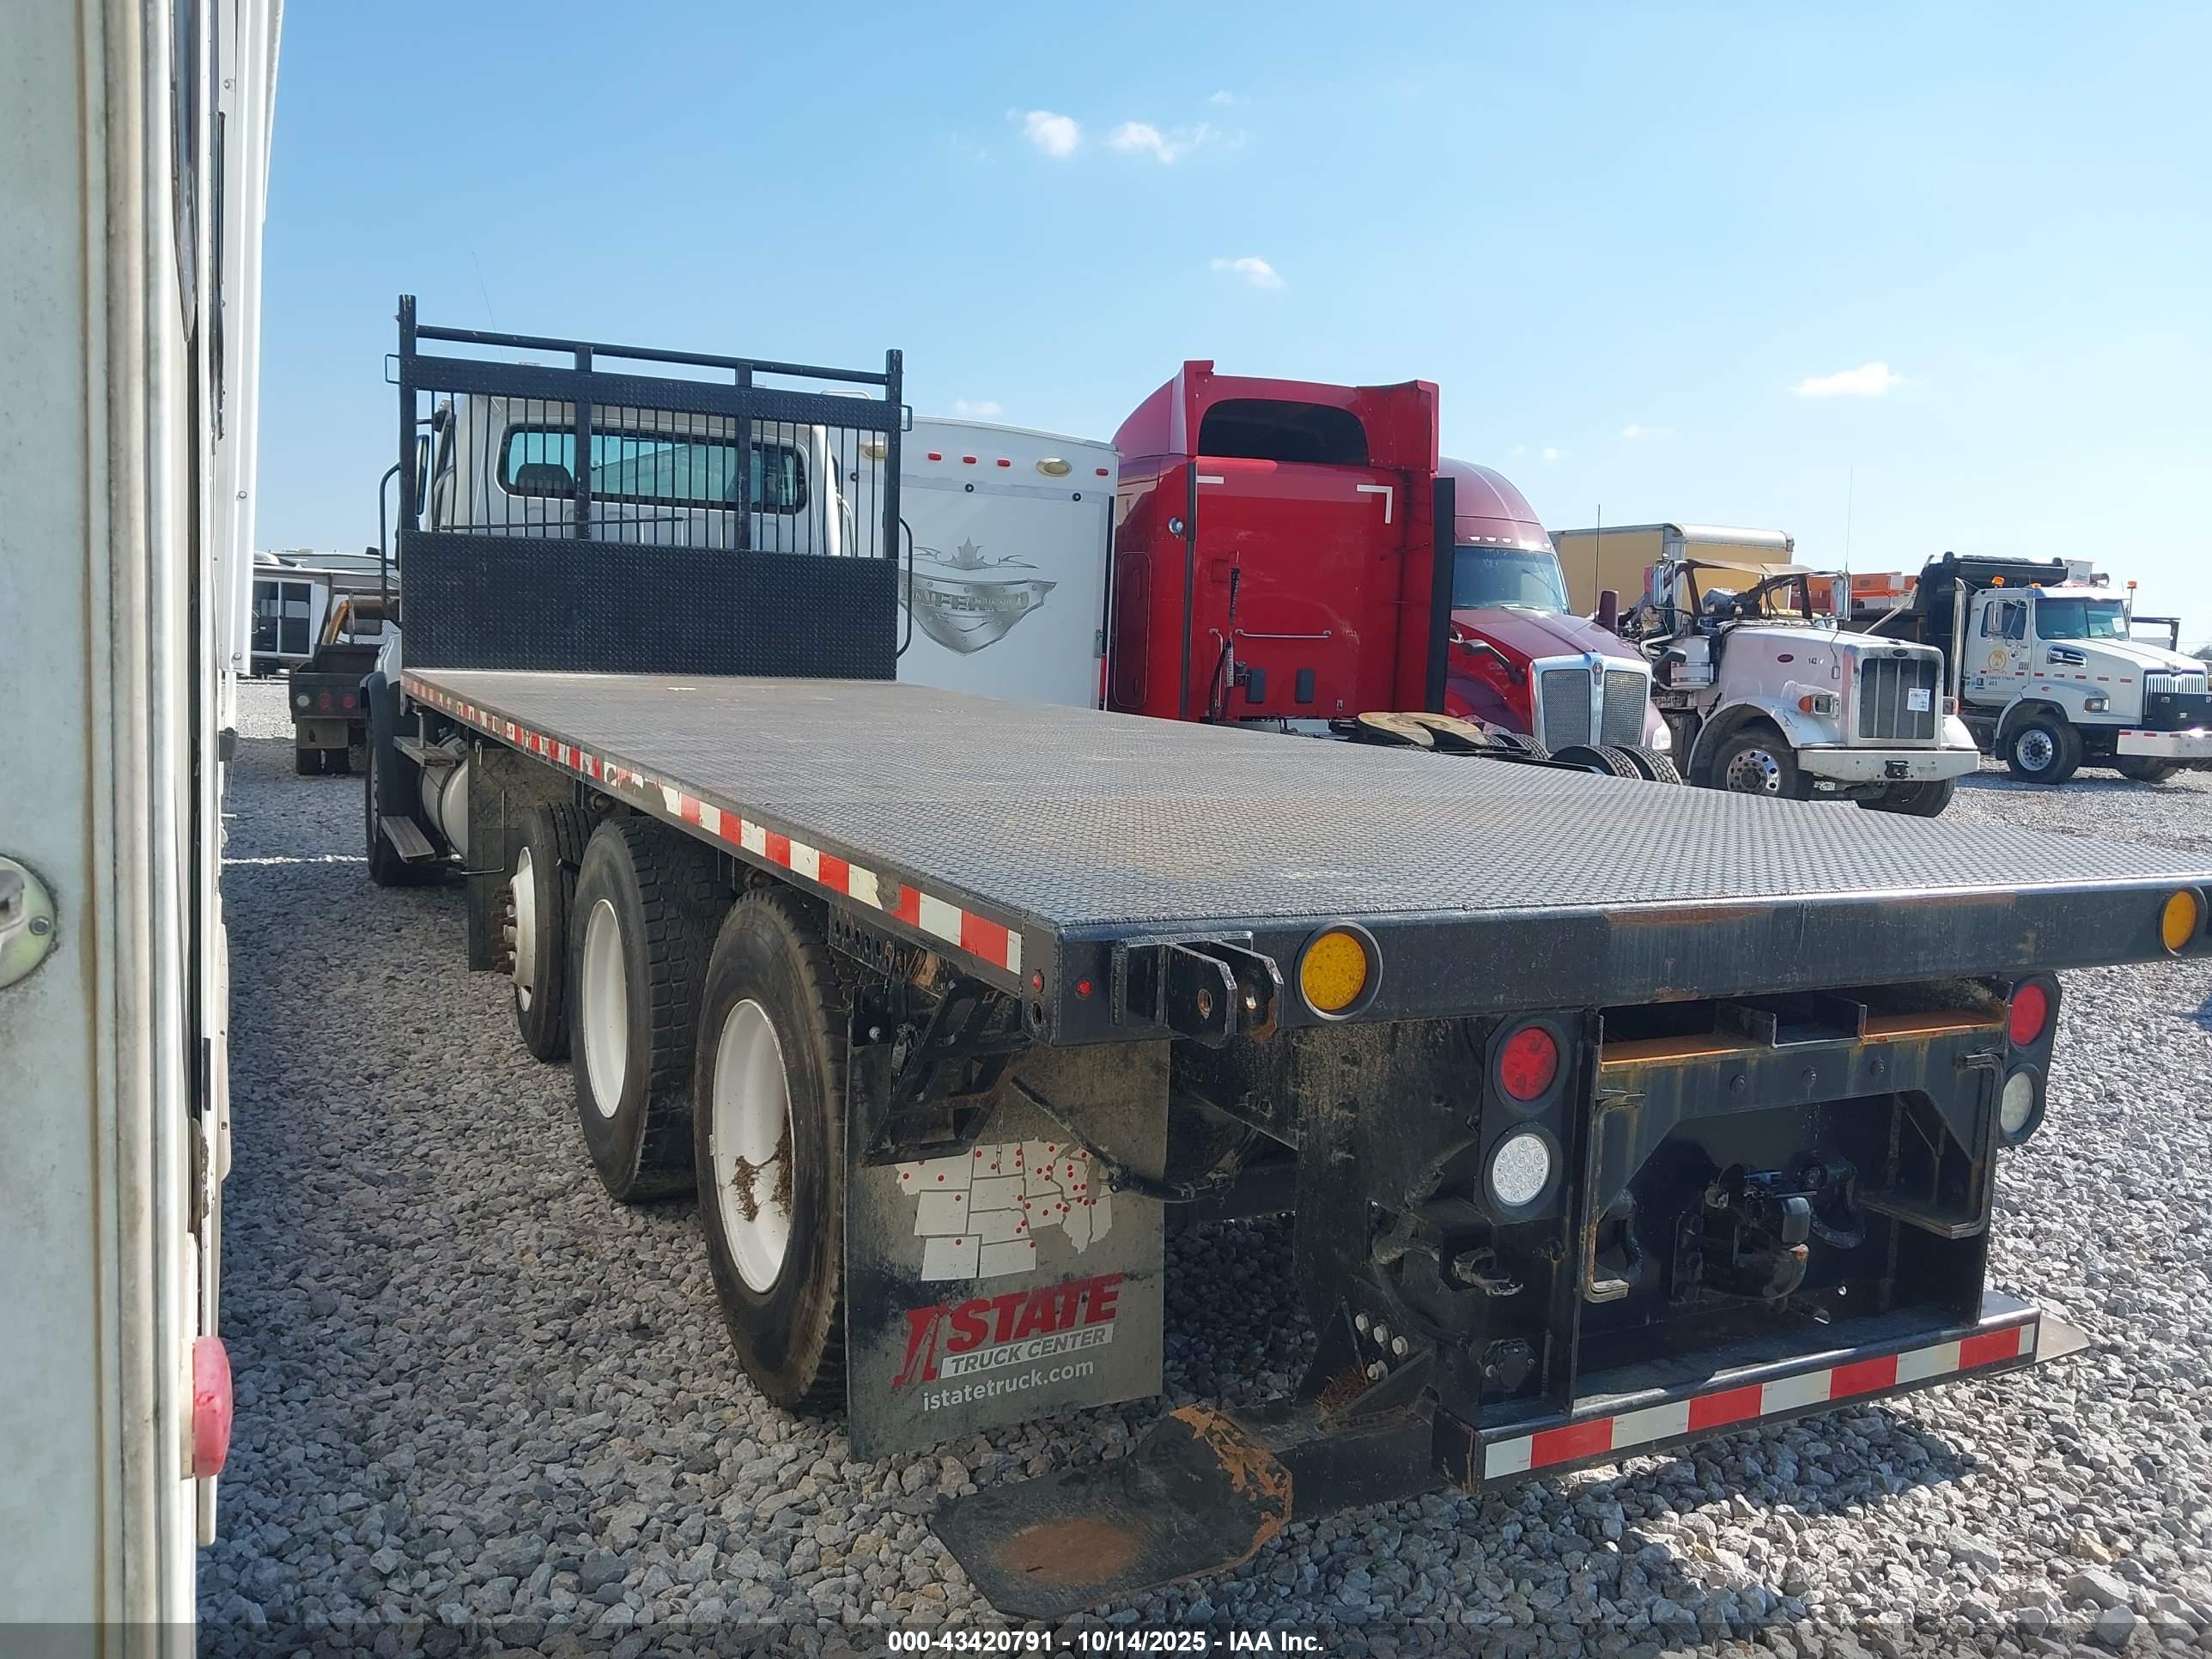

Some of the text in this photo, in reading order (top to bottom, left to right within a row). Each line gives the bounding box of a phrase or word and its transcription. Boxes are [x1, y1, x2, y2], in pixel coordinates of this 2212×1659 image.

[951, 1328, 1106, 1374] TRUCK CENTER
[923, 1359, 1094, 1412] istatetruck.com
